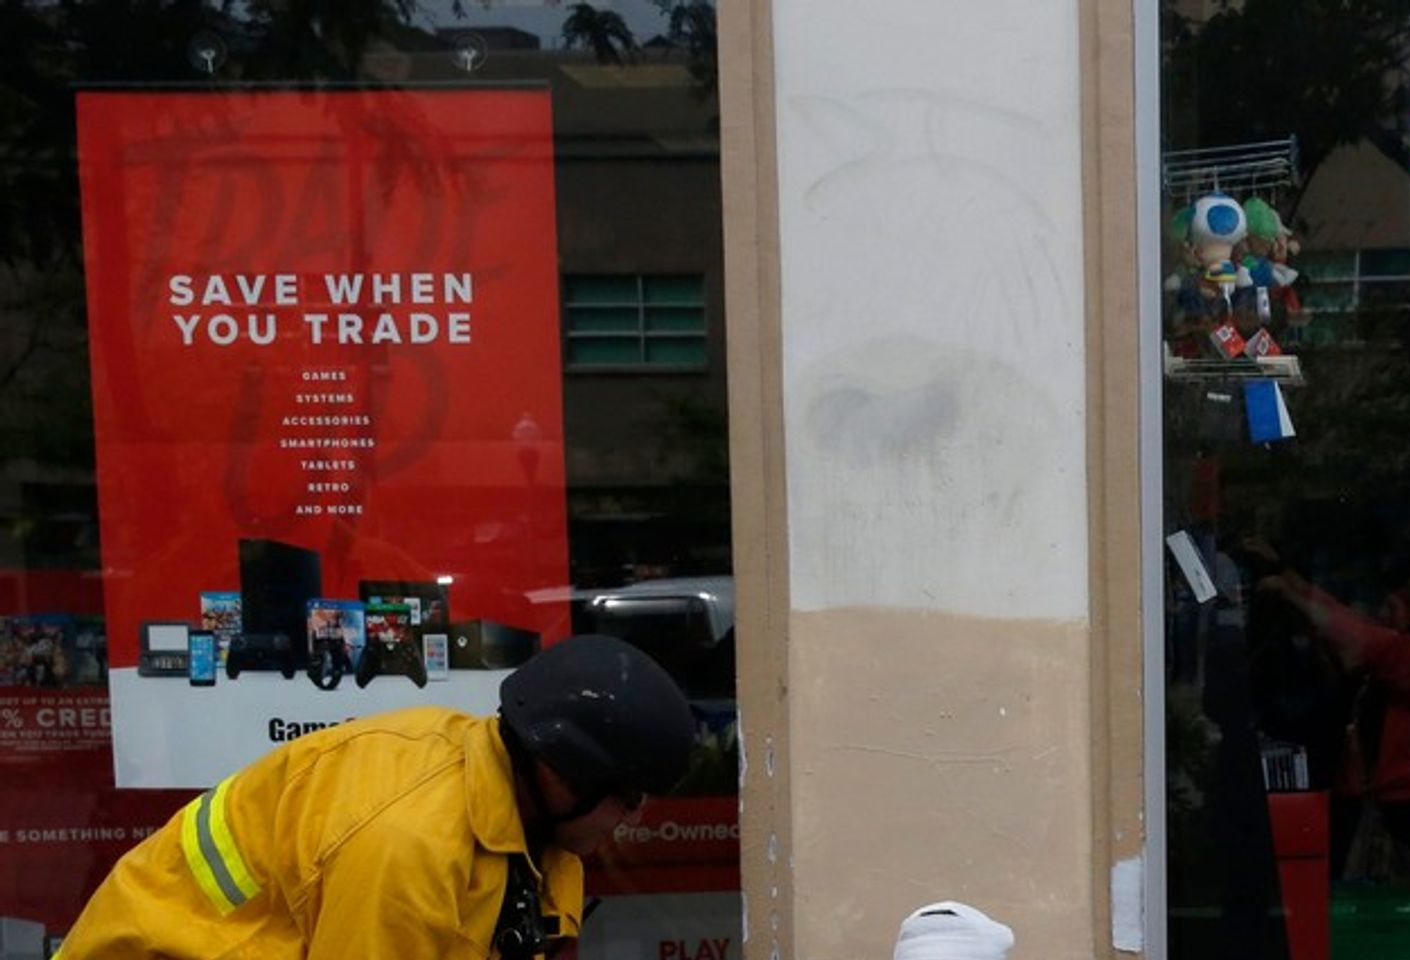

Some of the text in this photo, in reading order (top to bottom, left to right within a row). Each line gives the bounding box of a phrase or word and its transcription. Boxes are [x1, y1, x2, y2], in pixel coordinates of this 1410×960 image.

[168, 272, 474, 306] SAVE WHEN
[173, 312, 472, 346] YOU TRADE
[302, 371, 346, 381] GAMES
[295, 393, 354, 404] SYSTEMS
[282, 416, 370, 426] ACCESSORIES
[279, 438, 375, 449] SMARTPHONES
[301, 460, 355, 470] TABLETS
[307, 482, 350, 493] RETRO
[295, 504, 364, 515] AND MORE
[16, 828, 127, 843] SOMETHING
